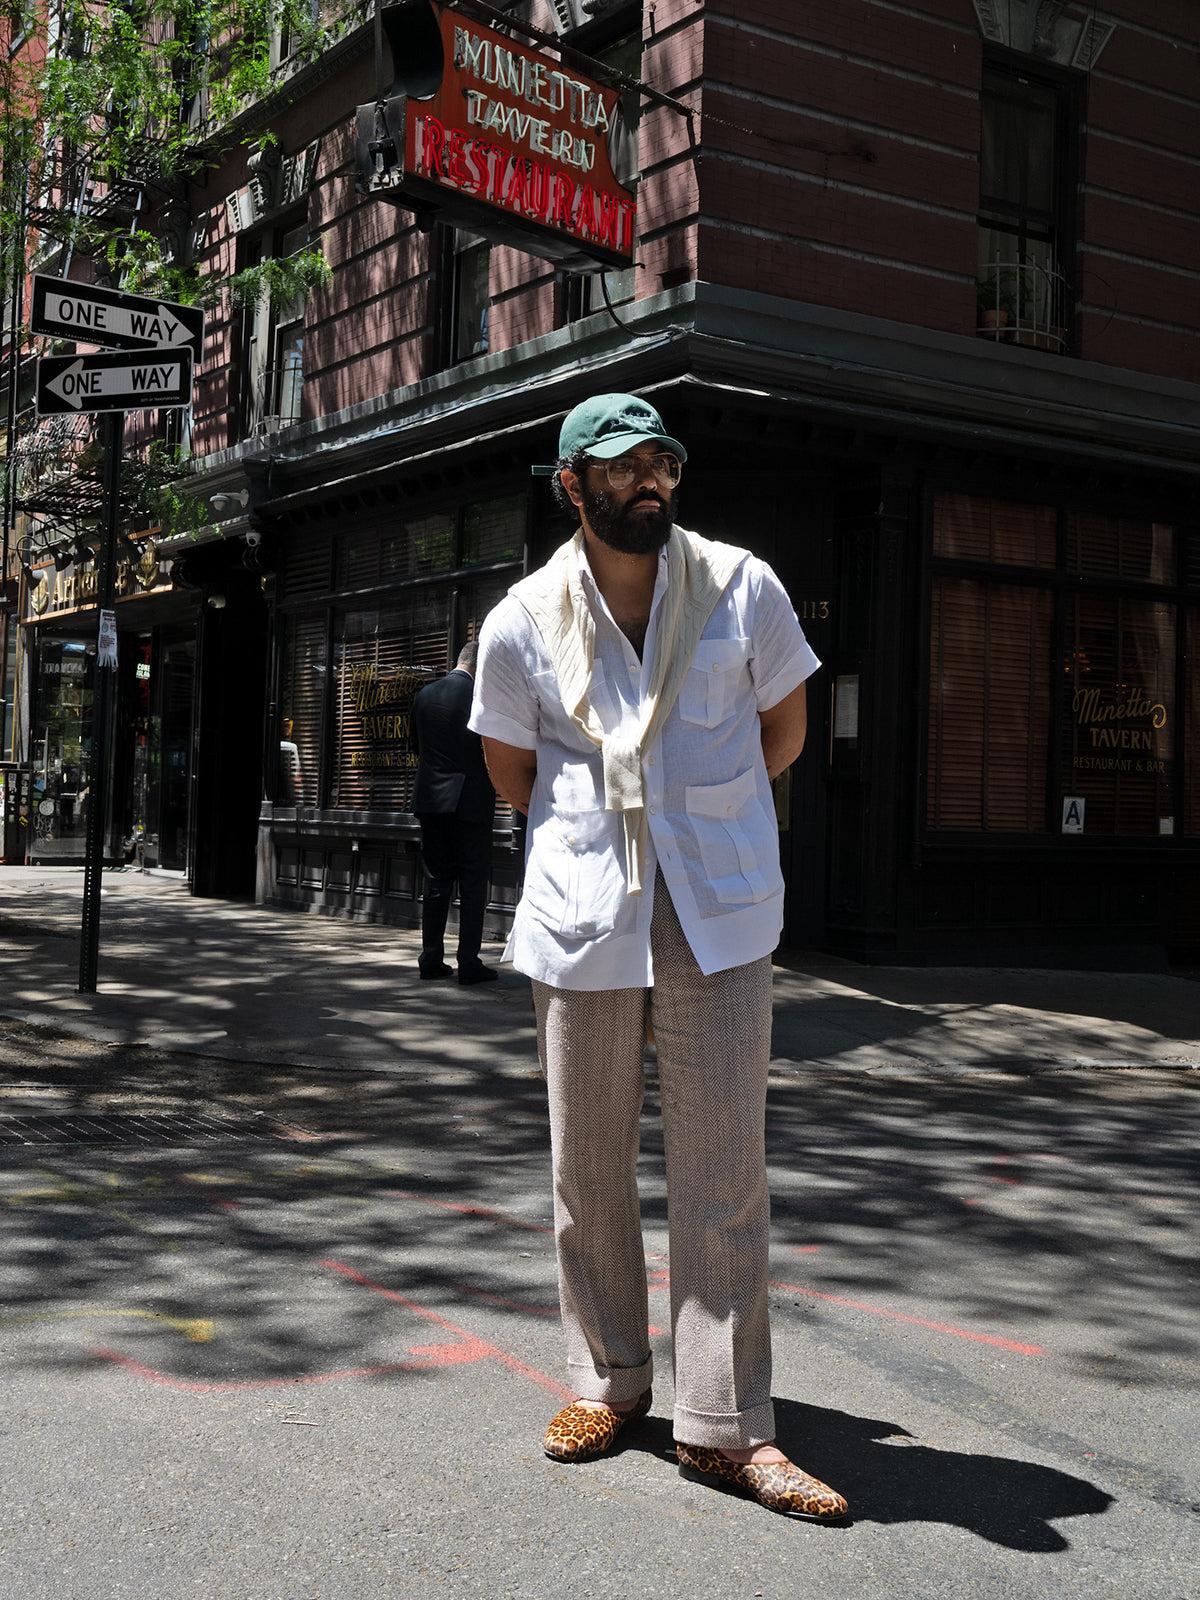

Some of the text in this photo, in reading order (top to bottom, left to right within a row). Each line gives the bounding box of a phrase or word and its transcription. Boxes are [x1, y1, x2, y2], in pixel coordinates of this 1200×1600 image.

[454, 26, 609, 133] MINETTA
[466, 89, 596, 172] TAVERN
[415, 115, 638, 250] RESTAURANT
[58, 299, 179, 342] ONE WAY
[62, 366, 175, 396] ONE WAY
[51, 558, 127, 605] Artiche
[801, 600, 830, 619] 113
[349, 662, 426, 714] Minetta
[1072, 686, 1167, 729] Minetta
[361, 715, 411, 739] TAVERN
[1090, 727, 1152, 750] TAVERN
[351, 752, 395, 767] RESTAURANT
[1073, 756, 1166, 774] RESTAURANT & BAR
[1064, 800, 1081, 825] A
